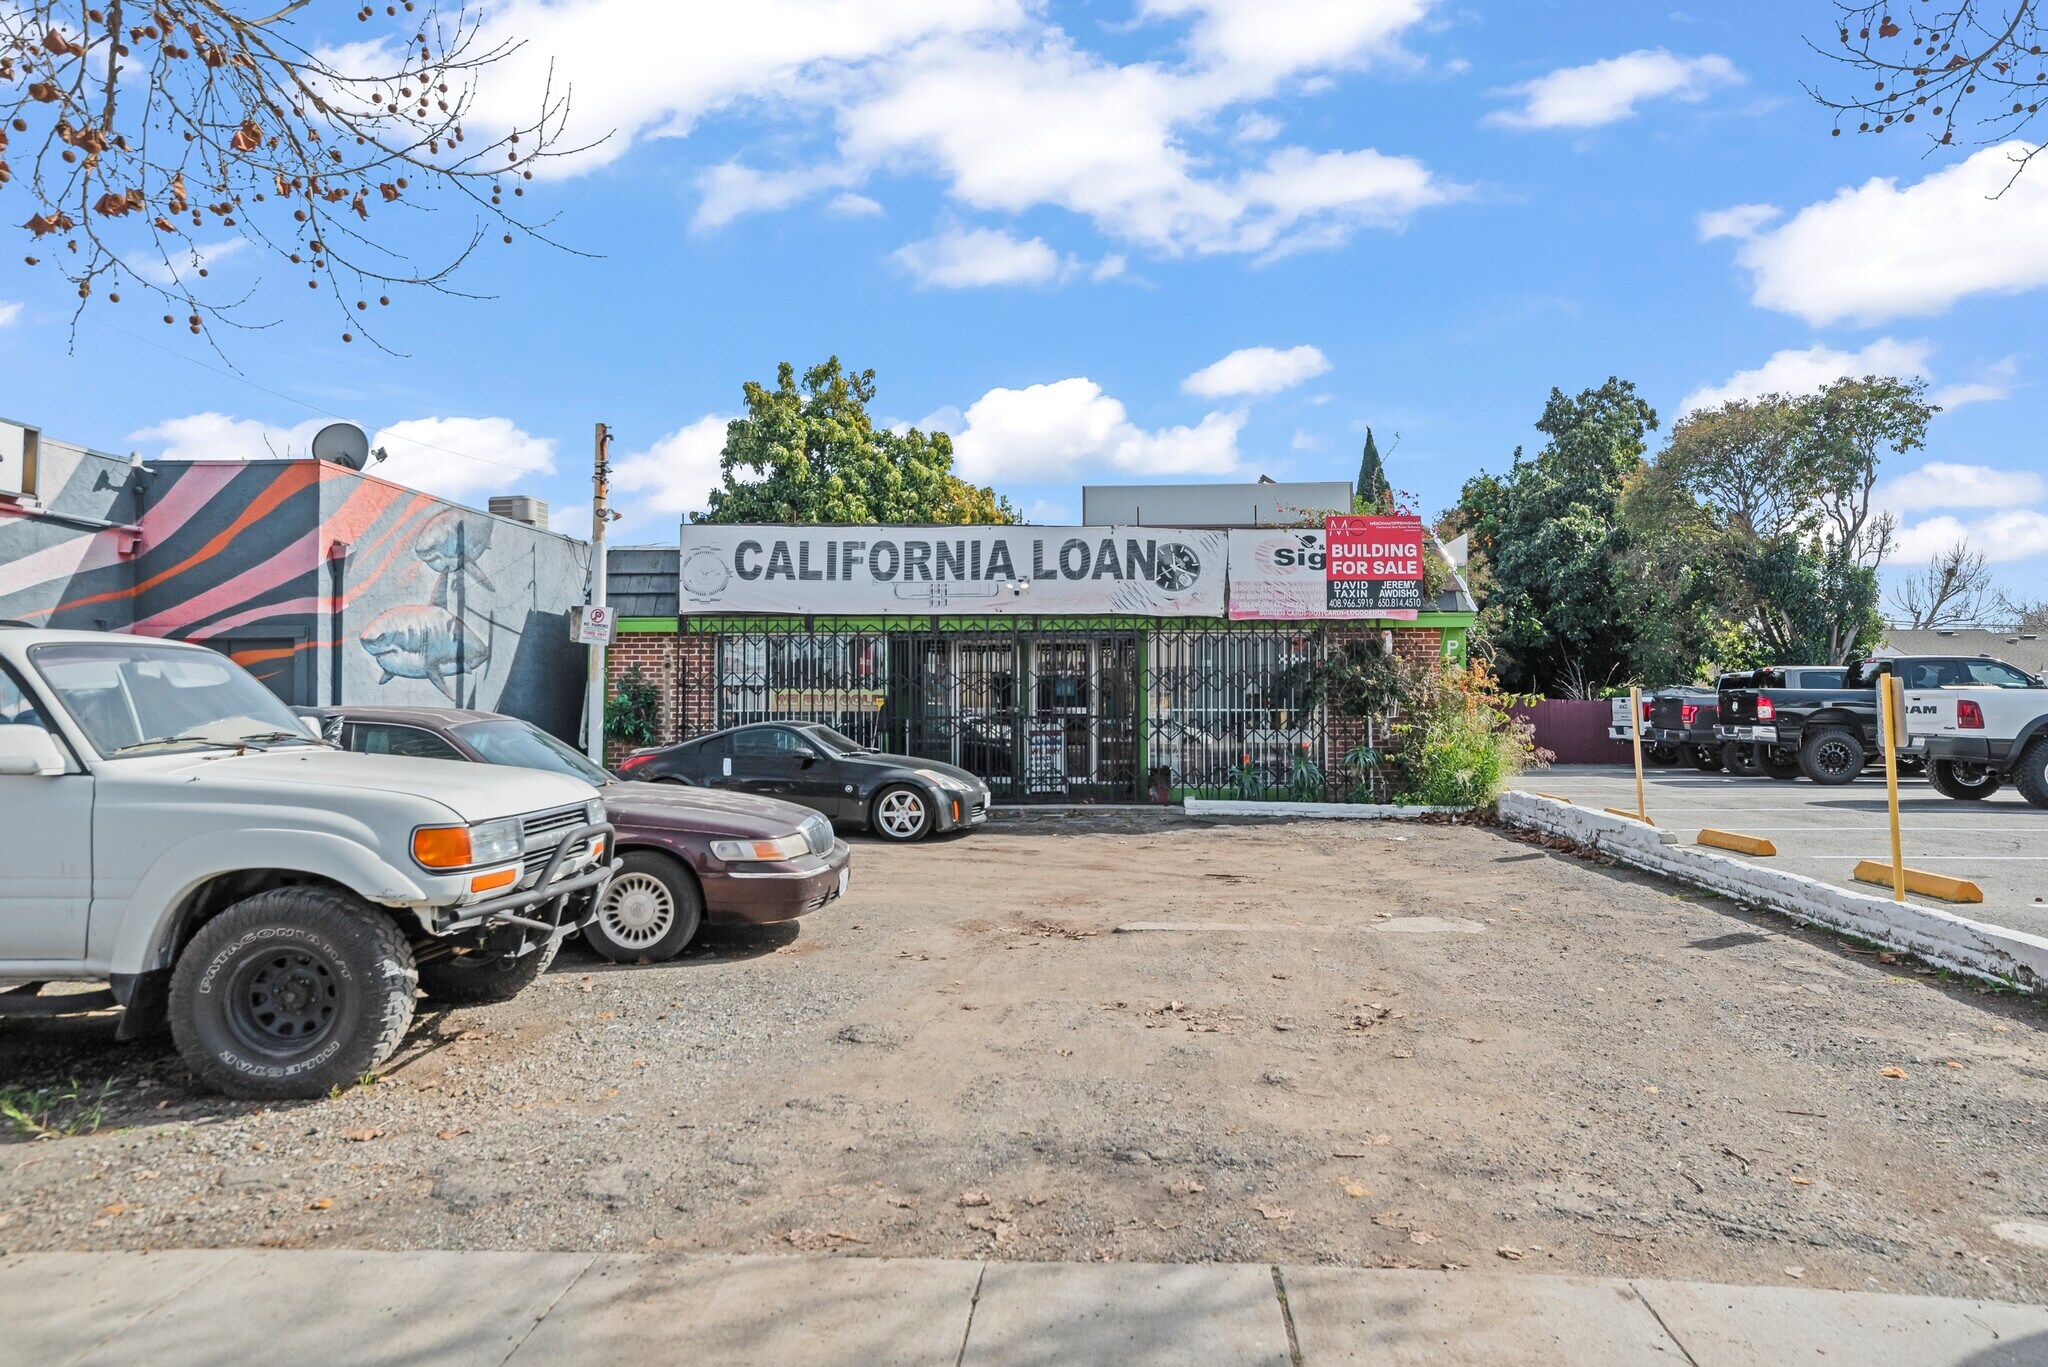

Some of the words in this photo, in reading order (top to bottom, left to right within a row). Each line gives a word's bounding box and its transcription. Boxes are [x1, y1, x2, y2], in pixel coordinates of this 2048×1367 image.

[1331, 543, 1417, 558] BUILDING
[734, 540, 1016, 581] CALIFORNIA
[1033, 538, 1157, 581] LOAN
[1274, 548, 1326, 570] Sig
[1332, 561, 1368, 575] FOR
[1373, 560, 1418, 575] SALE
[1333, 581, 1368, 590] DAVID
[1381, 580, 1416, 589] JEREMY
[1334, 589, 1368, 598] TAXIN
[1378, 589, 1419, 598] AWDISHO
[1328, 598, 1374, 608] 408.966.5919
[1377, 598, 1421, 608] 650.814.4510
[775, 694, 798, 706] WE
[803, 694, 835, 706] BUY
[1905, 705, 1937, 714] AM
[200, 928, 320, 993] PATAGONIA
[219, 1041, 340, 1077] MILESTAR
